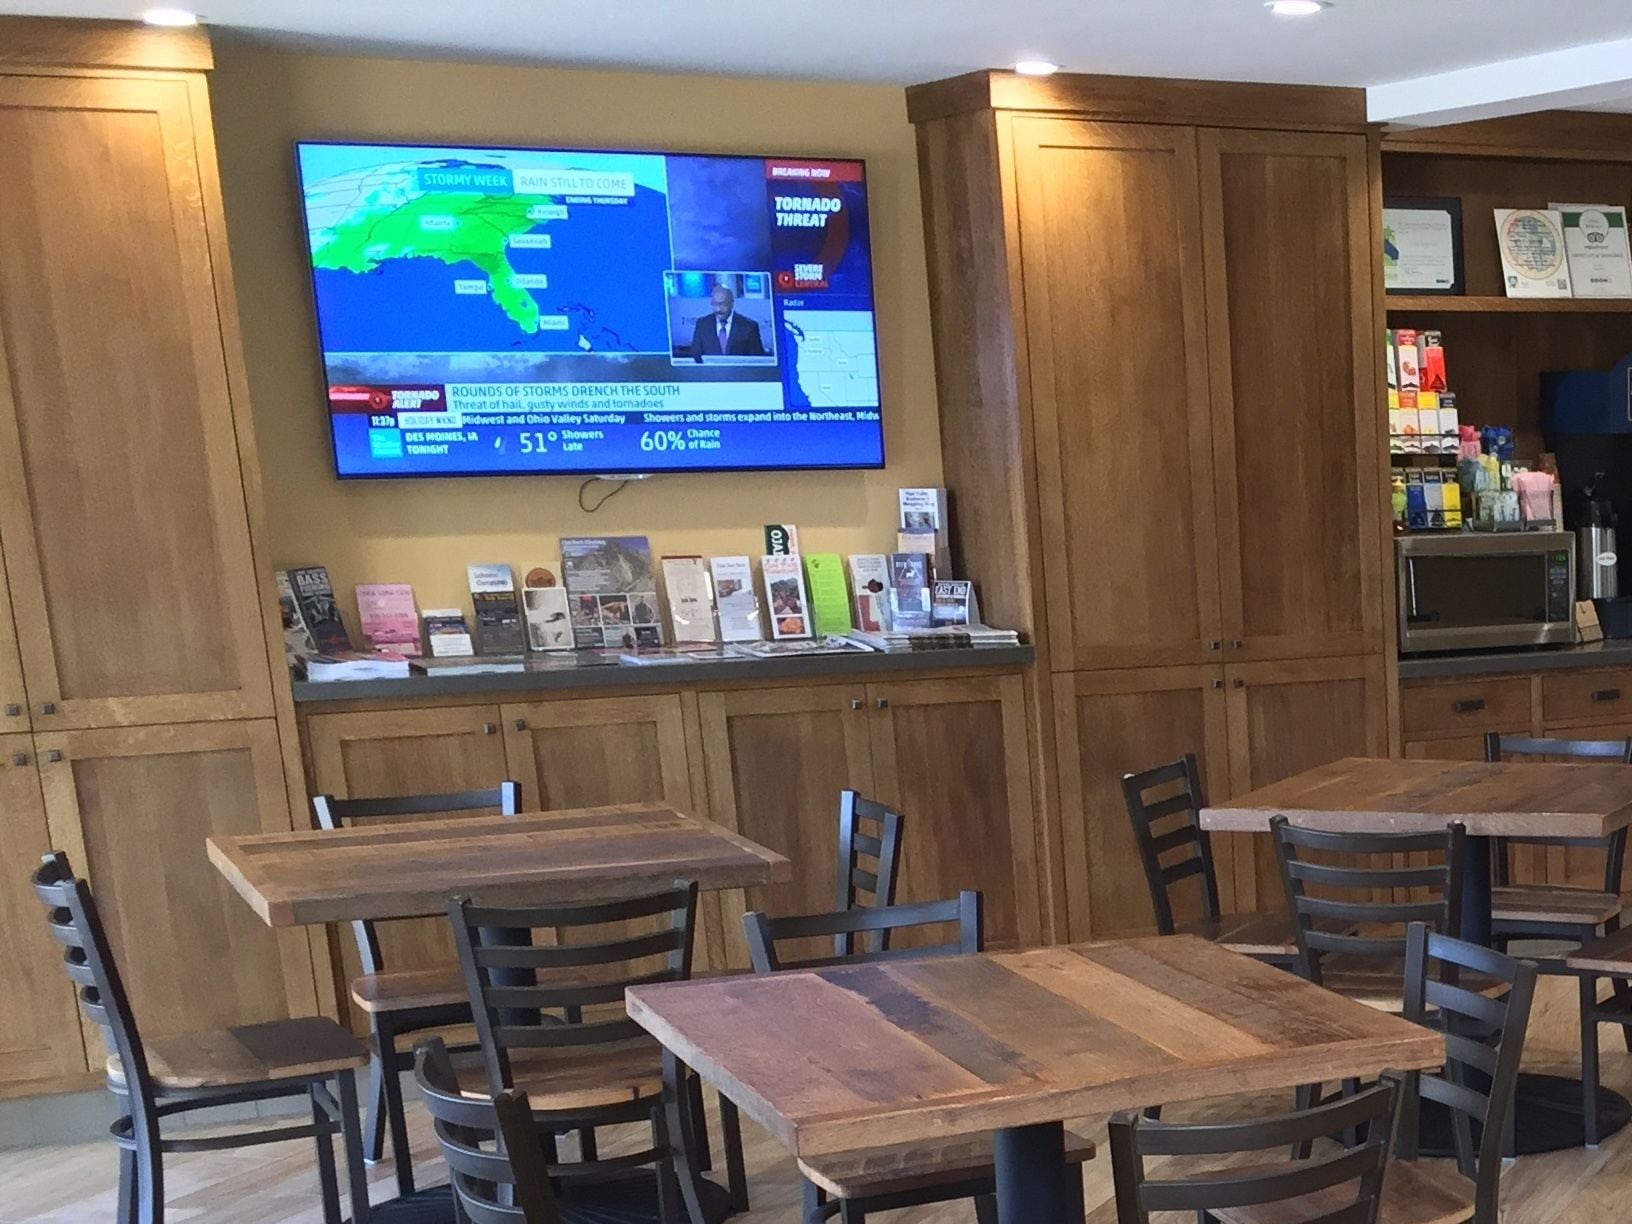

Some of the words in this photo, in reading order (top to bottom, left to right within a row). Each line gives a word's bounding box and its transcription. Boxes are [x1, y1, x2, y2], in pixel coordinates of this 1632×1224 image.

[424, 173, 472, 186] STORMY
[474, 174, 508, 187] WEEK
[521, 176, 548, 187] RAIN
[551, 177, 577, 188] STILL
[579, 177, 593, 188] TO
[595, 178, 628, 189] COME
[774, 197, 841, 212] TORNADO
[776, 213, 828, 227] THREAT
[391, 390, 440, 400] TORNADO
[452, 386, 501, 397] ROUNDS
[504, 386, 521, 397] OF
[523, 386, 568, 397] STORMS
[572, 386, 618, 396] DRENCH
[621, 385, 641, 396] THE
[643, 385, 680, 396] SOUTH
[392, 399, 422, 409] ALERT
[453, 400, 488, 410] Threat
[489, 400, 500, 410] of
[502, 400, 522, 410] hail,
[527, 400, 555, 412] gusty
[557, 400, 589, 409] winds
[591, 399, 610, 409] and
[613, 399, 664, 408] tornadoes
[462, 414, 504, 424] Midwest
[507, 414, 524, 424] and
[527, 414, 550, 424] Ohio
[551, 414, 582, 425] Valley
[583, 413, 625, 425] Saturday
[643, 413, 684, 423] Showers
[686, 413, 703, 422] and
[705, 413, 736, 422] storms
[738, 413, 771, 423] expand
[773, 412, 791, 421] into
[793, 412, 808, 421] the
[405, 432, 424, 442] DES
[561, 430, 603, 440] Showers
[687, 429, 720, 438] Chance
[562, 441, 583, 452] Late
[640, 431, 685, 451] 60%
[688, 440, 698, 449] of
[700, 439, 720, 449] Rain
[406, 445, 449, 455] TONIGHT
